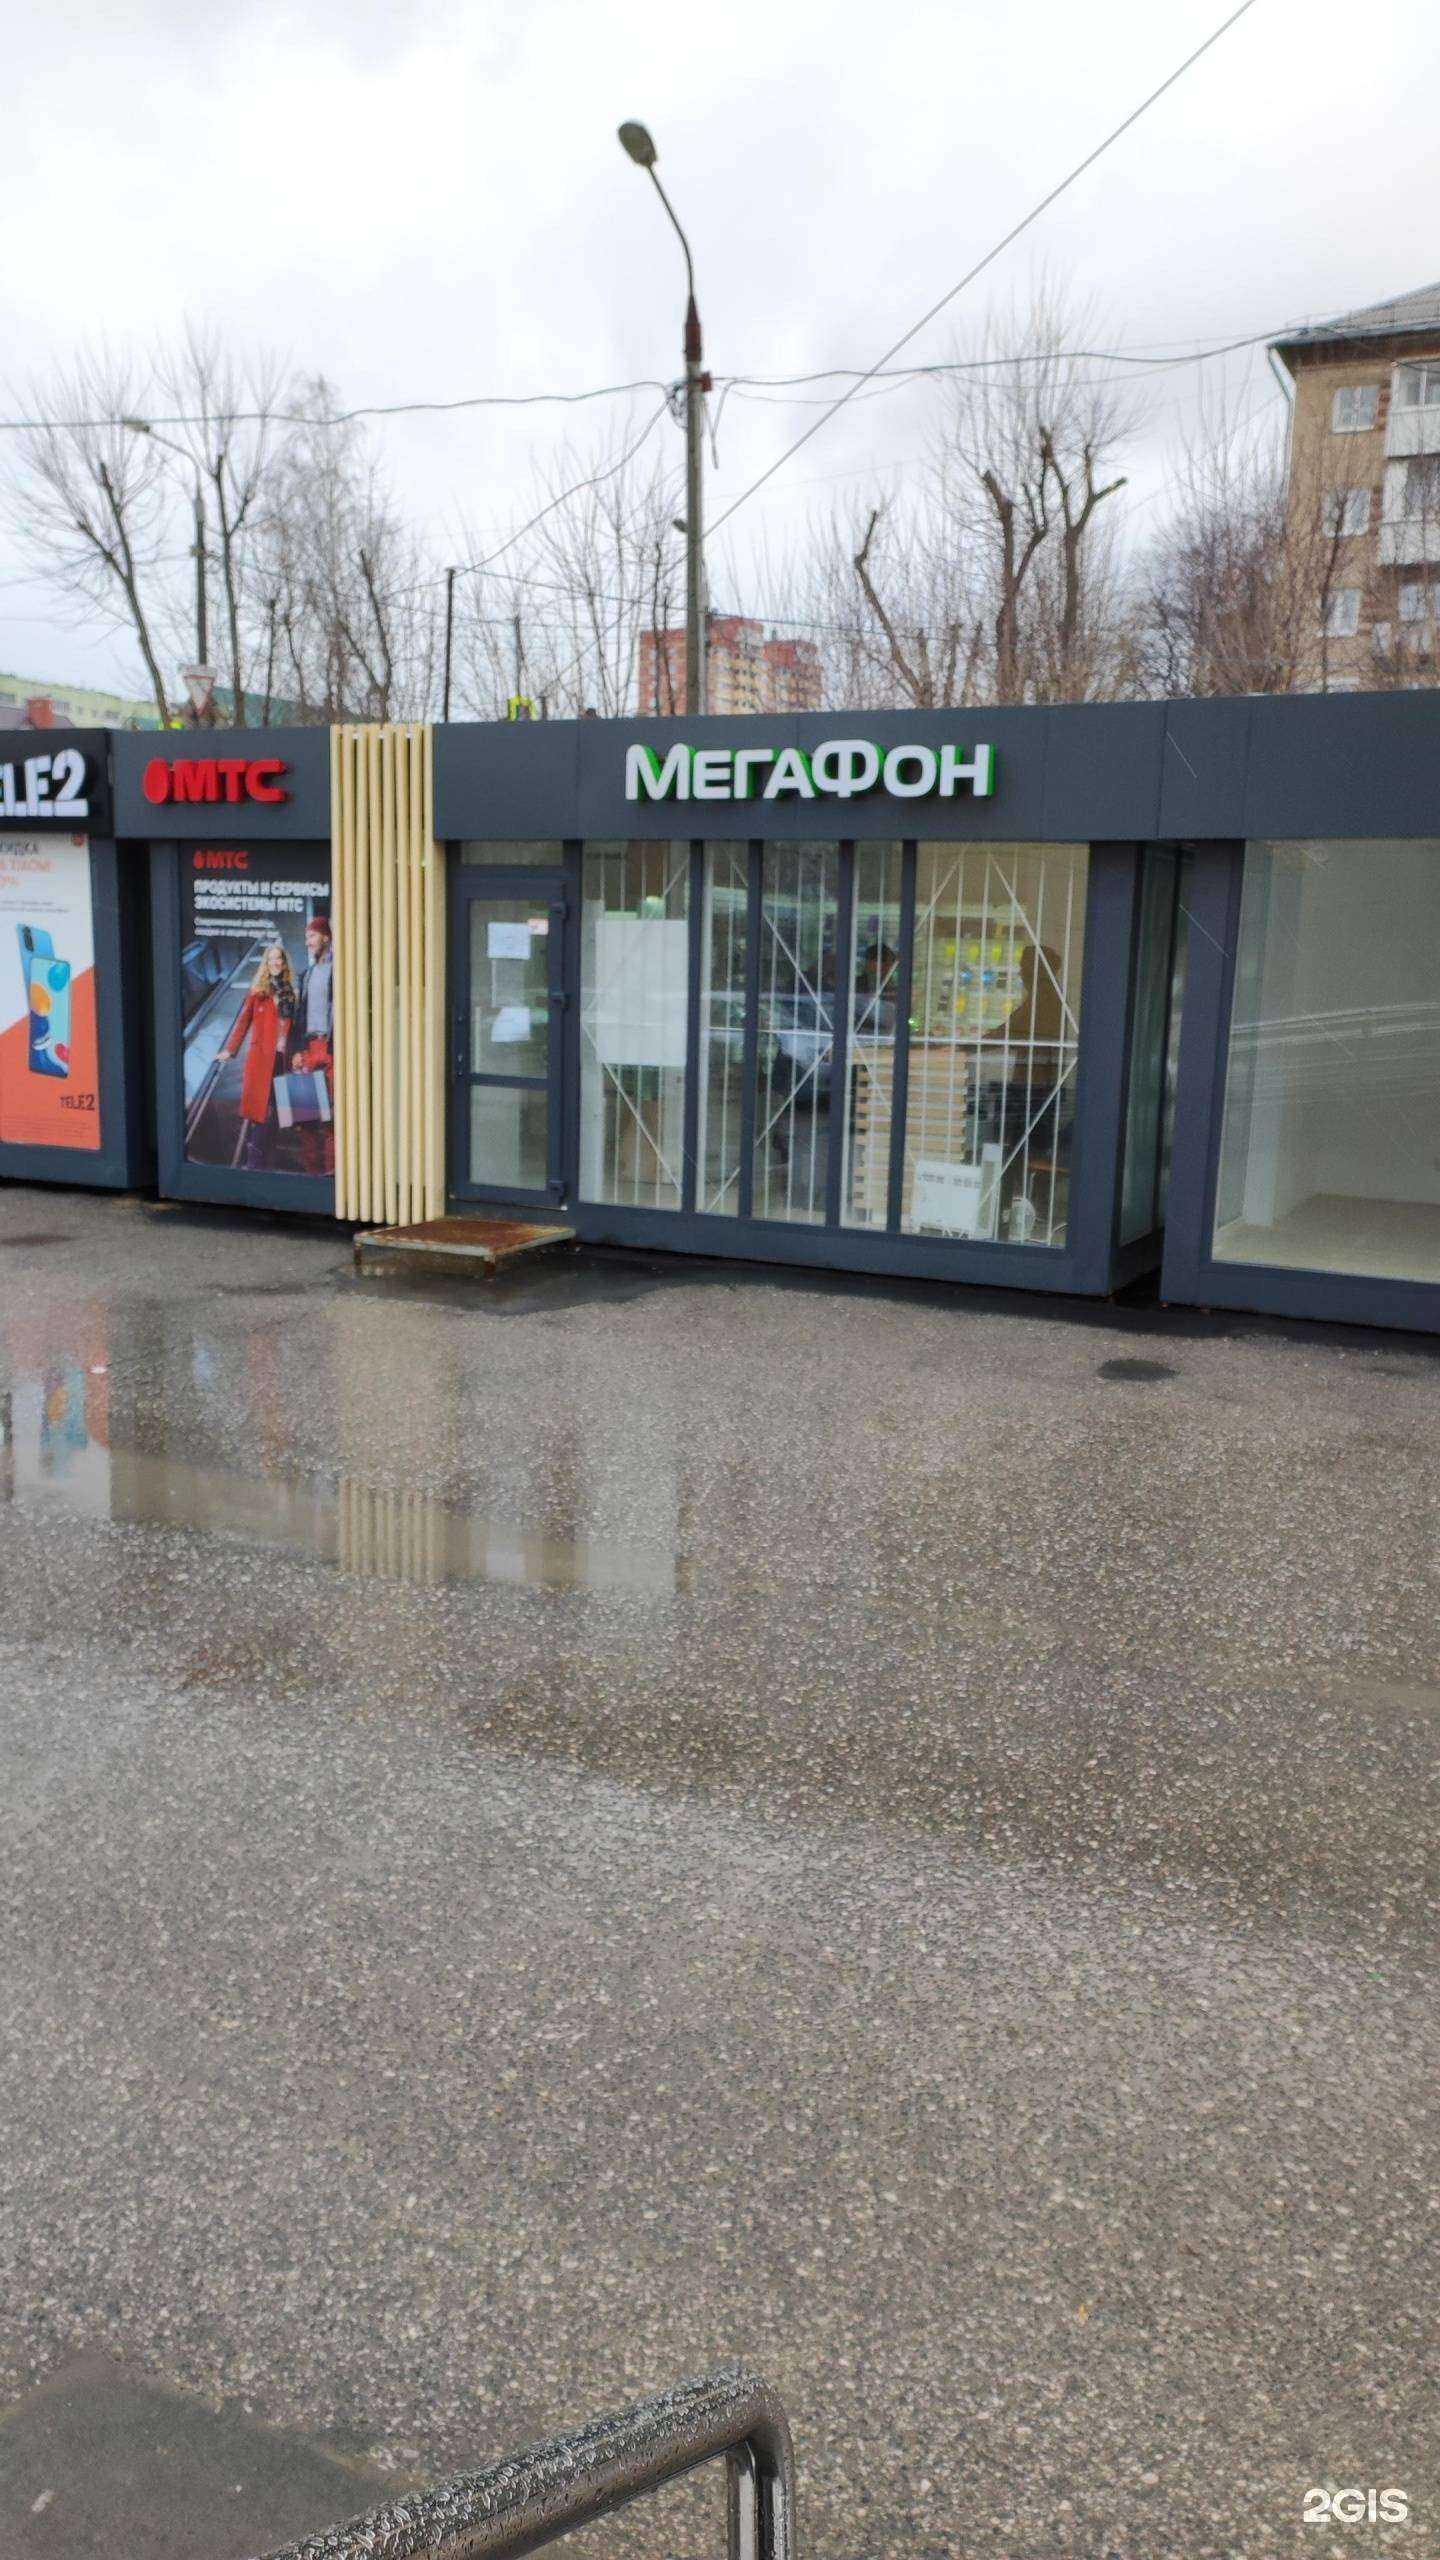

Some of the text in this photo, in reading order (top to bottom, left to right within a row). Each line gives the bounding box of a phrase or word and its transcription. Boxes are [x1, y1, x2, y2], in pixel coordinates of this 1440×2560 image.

[625, 739, 992, 800] МЕГАФОН
[0, 748, 88, 817] LE2
[173, 759, 286, 803] МТС
[206, 850, 249, 869] МТС
[193, 879, 260, 896] ПРОДУКТЫ
[271, 881, 330, 897] СЕРВИСЫ
[194, 895, 304, 913] ЭКОСИСТЕМЫ МТС
[60, 1094, 96, 1111] TELE2
